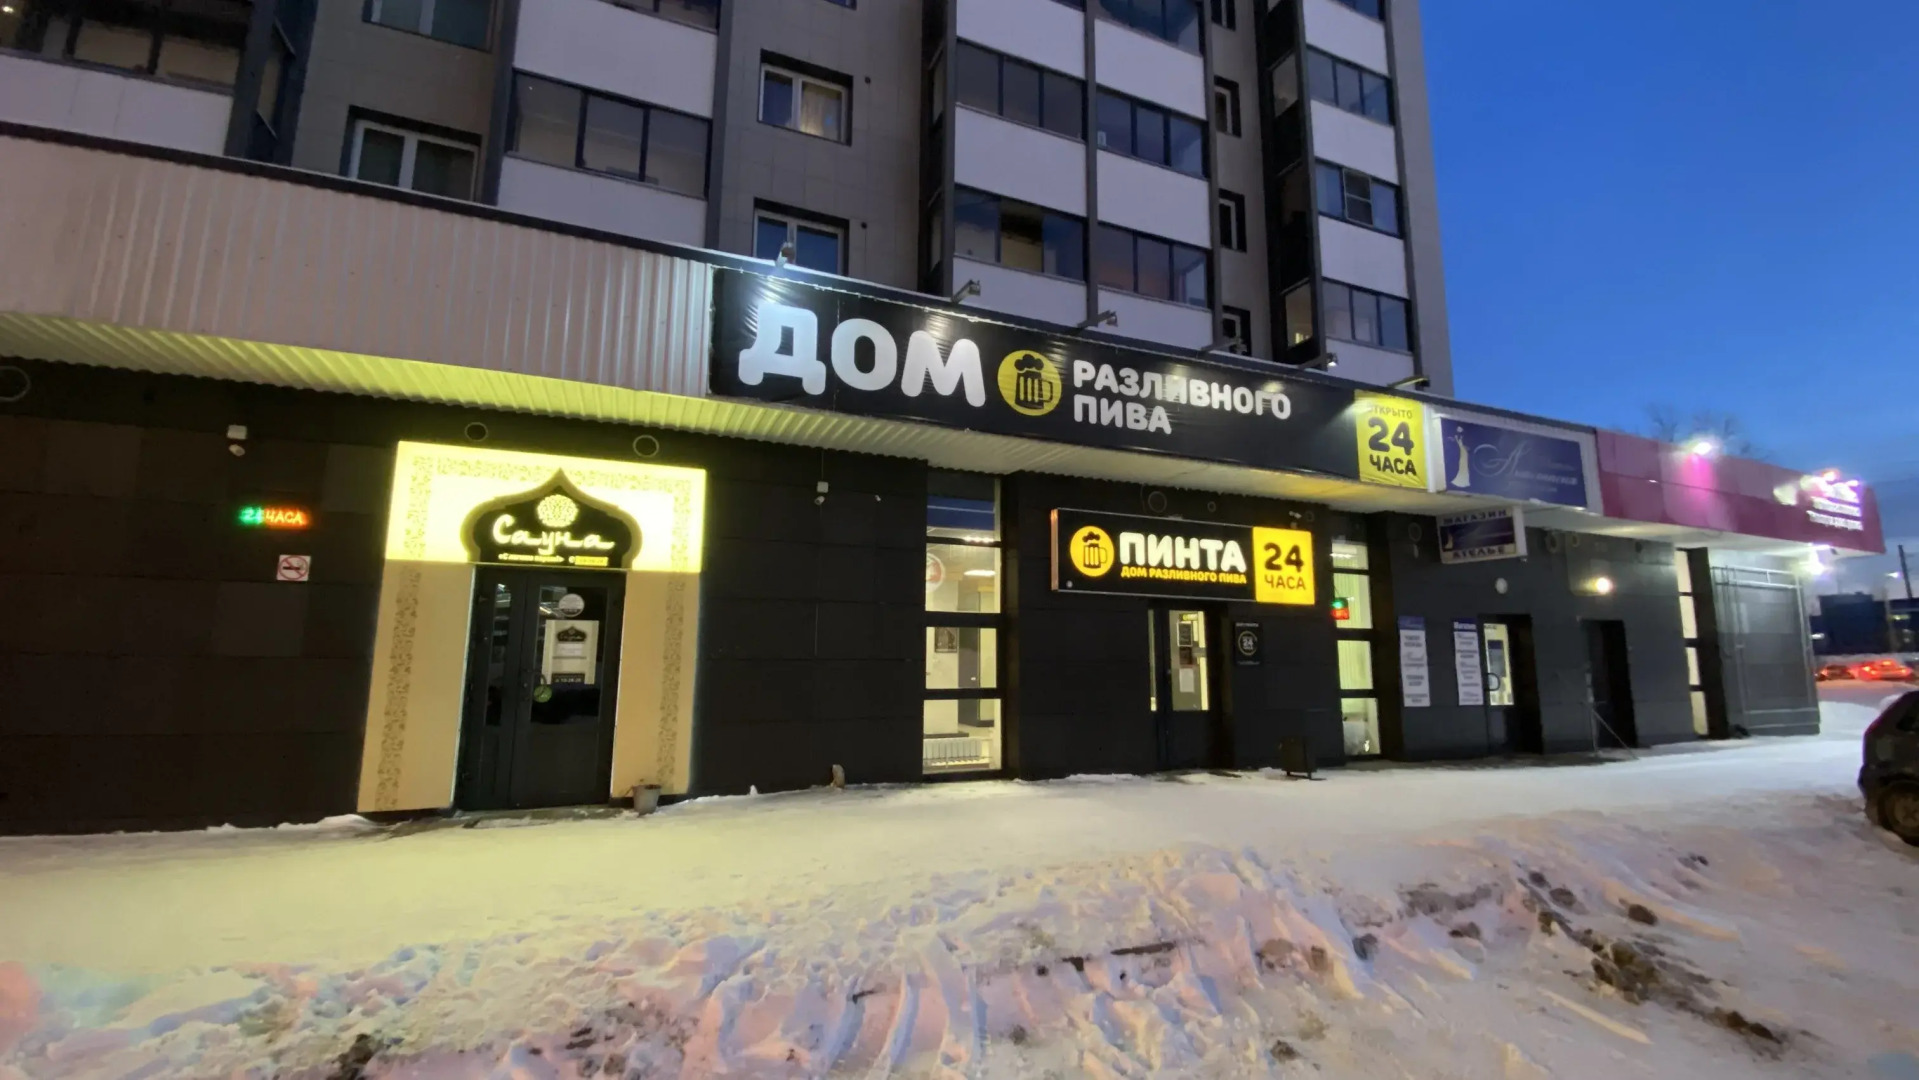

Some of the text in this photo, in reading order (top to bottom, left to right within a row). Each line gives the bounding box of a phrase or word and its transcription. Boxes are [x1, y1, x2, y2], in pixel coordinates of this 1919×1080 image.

[738, 302, 986, 407] ДОМ
[1073, 359, 1291, 420] РАЗЛИВНОГО
[1073, 394, 1172, 434] ПИВА
[1368, 417, 1414, 456] 24
[1370, 454, 1417, 476] ЧАСА
[265, 509, 304, 524] ЧАСА
[493, 514, 615, 555] Сауна
[1119, 532, 1247, 573] ПИНТА
[1264, 542, 1304, 573] 24
[1121, 566, 1247, 584] ДОМ РАЗЛИВНОГО ПИВА
[1264, 575, 1306, 590] ЧАСА
